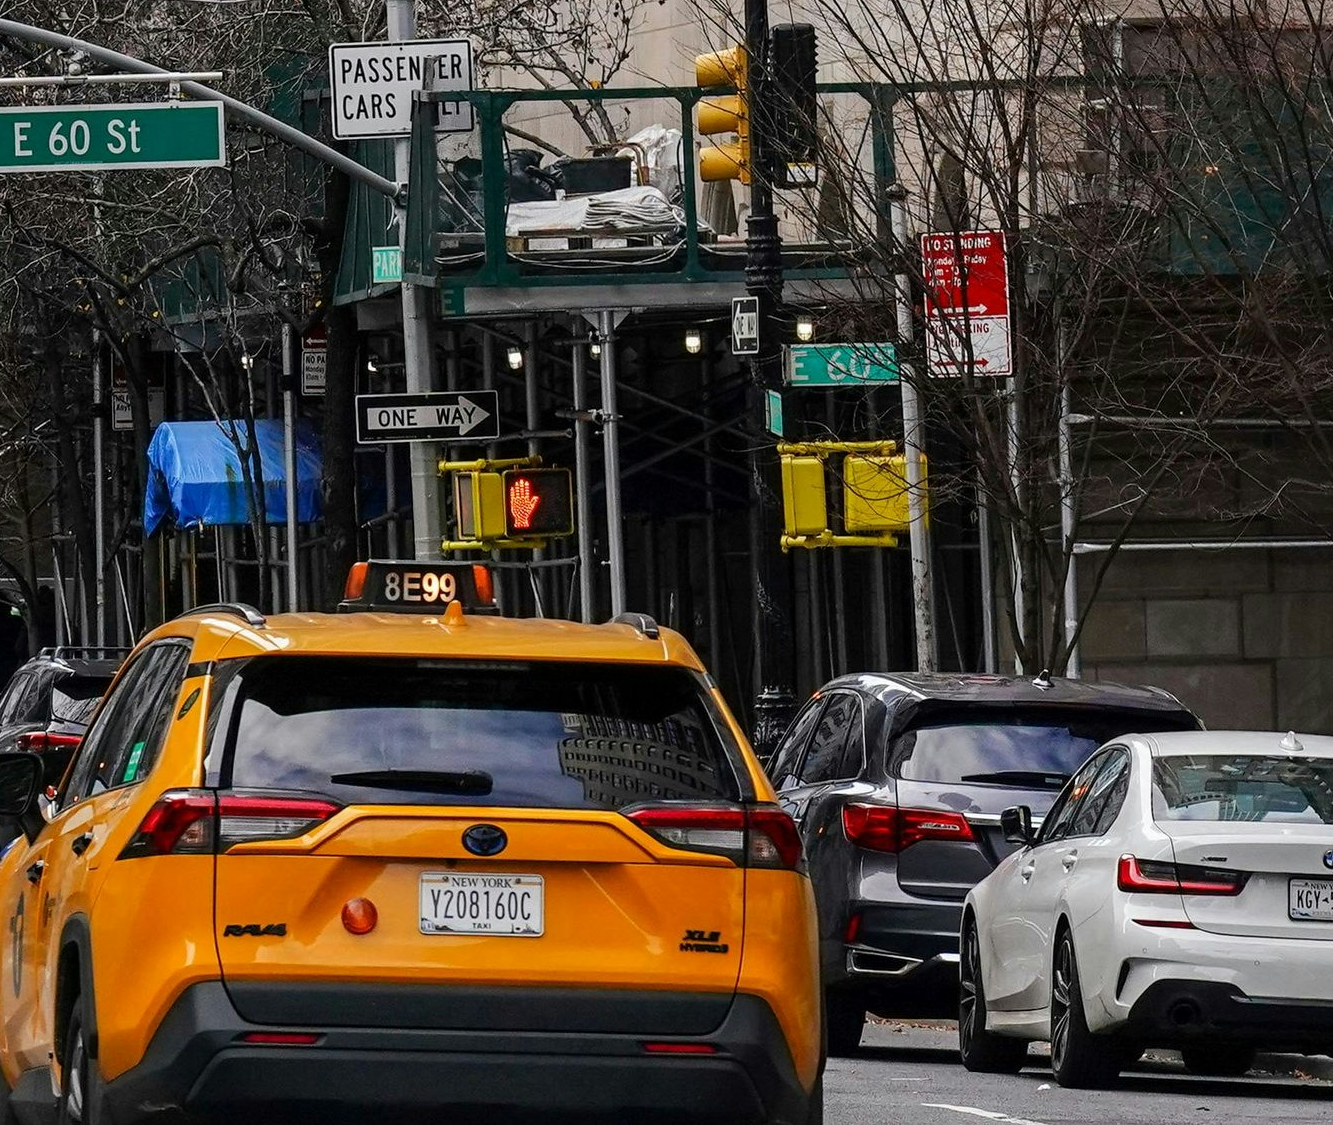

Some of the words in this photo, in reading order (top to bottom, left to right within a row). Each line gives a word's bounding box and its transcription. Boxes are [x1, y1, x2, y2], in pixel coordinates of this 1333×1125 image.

[341, 54, 462, 84] PASSENER
[343, 93, 397, 120] CARS
[15, 122, 33, 157] E
[49, 119, 90, 156] 60
[107, 119, 141, 154] St
[943, 237, 992, 251] STNDING
[791, 351, 809, 381] E
[827, 350, 871, 381] 60
[378, 409, 418, 426] ONE
[436, 407, 476, 425] WAY
[385, 572, 456, 602] 8E99
[452, 877, 479, 887] NEW
[481, 878, 512, 888] YORK
[431, 889, 531, 921] Y208160C
[1297, 890, 1321, 909] KGY
[223, 923, 287, 937] RAV4
[472, 922, 492, 930] TAXI
[683, 930, 721, 942] XLE
